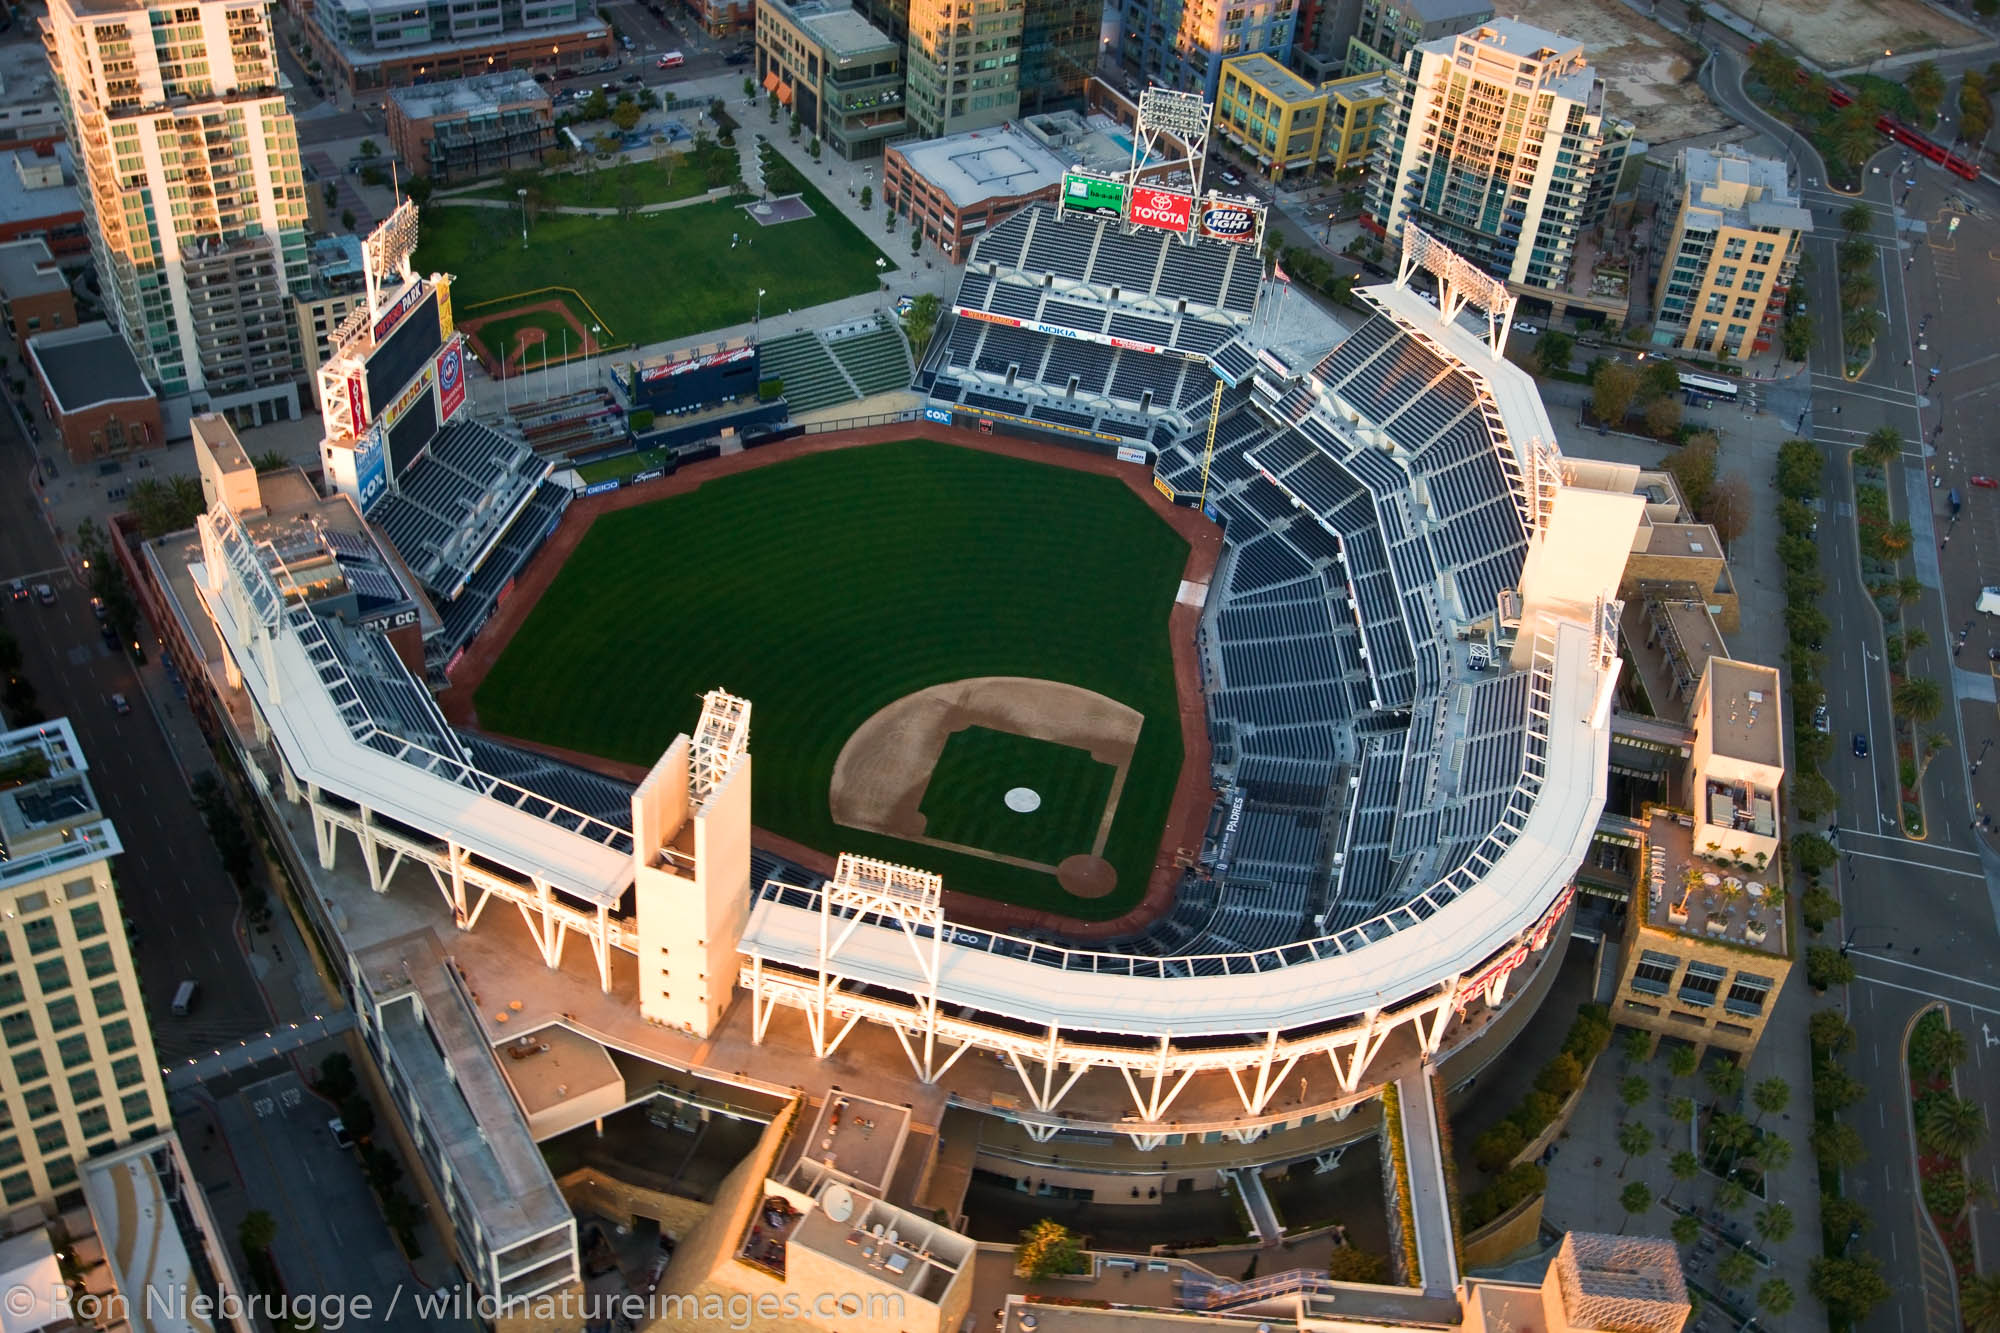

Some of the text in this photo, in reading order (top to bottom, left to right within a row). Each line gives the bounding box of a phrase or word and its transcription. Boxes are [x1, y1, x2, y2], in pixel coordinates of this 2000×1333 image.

[1134, 206, 1185, 225] TOYOTA
[1212, 211, 1248, 221] BUD
[1206, 218, 1251, 229] LIGHT
[402, 282, 422, 313] PARK
[1038, 324, 1077, 338] NOKIA
[926, 409, 949, 422] COX
[360, 474, 384, 505] COX
[587, 481, 618, 495] GEICO
[395, 611, 420, 626] CO.
[1226, 797, 1243, 833] PADRES
[941, 929, 979, 944] ETCO
[1456, 945, 1529, 1012] PETCO
